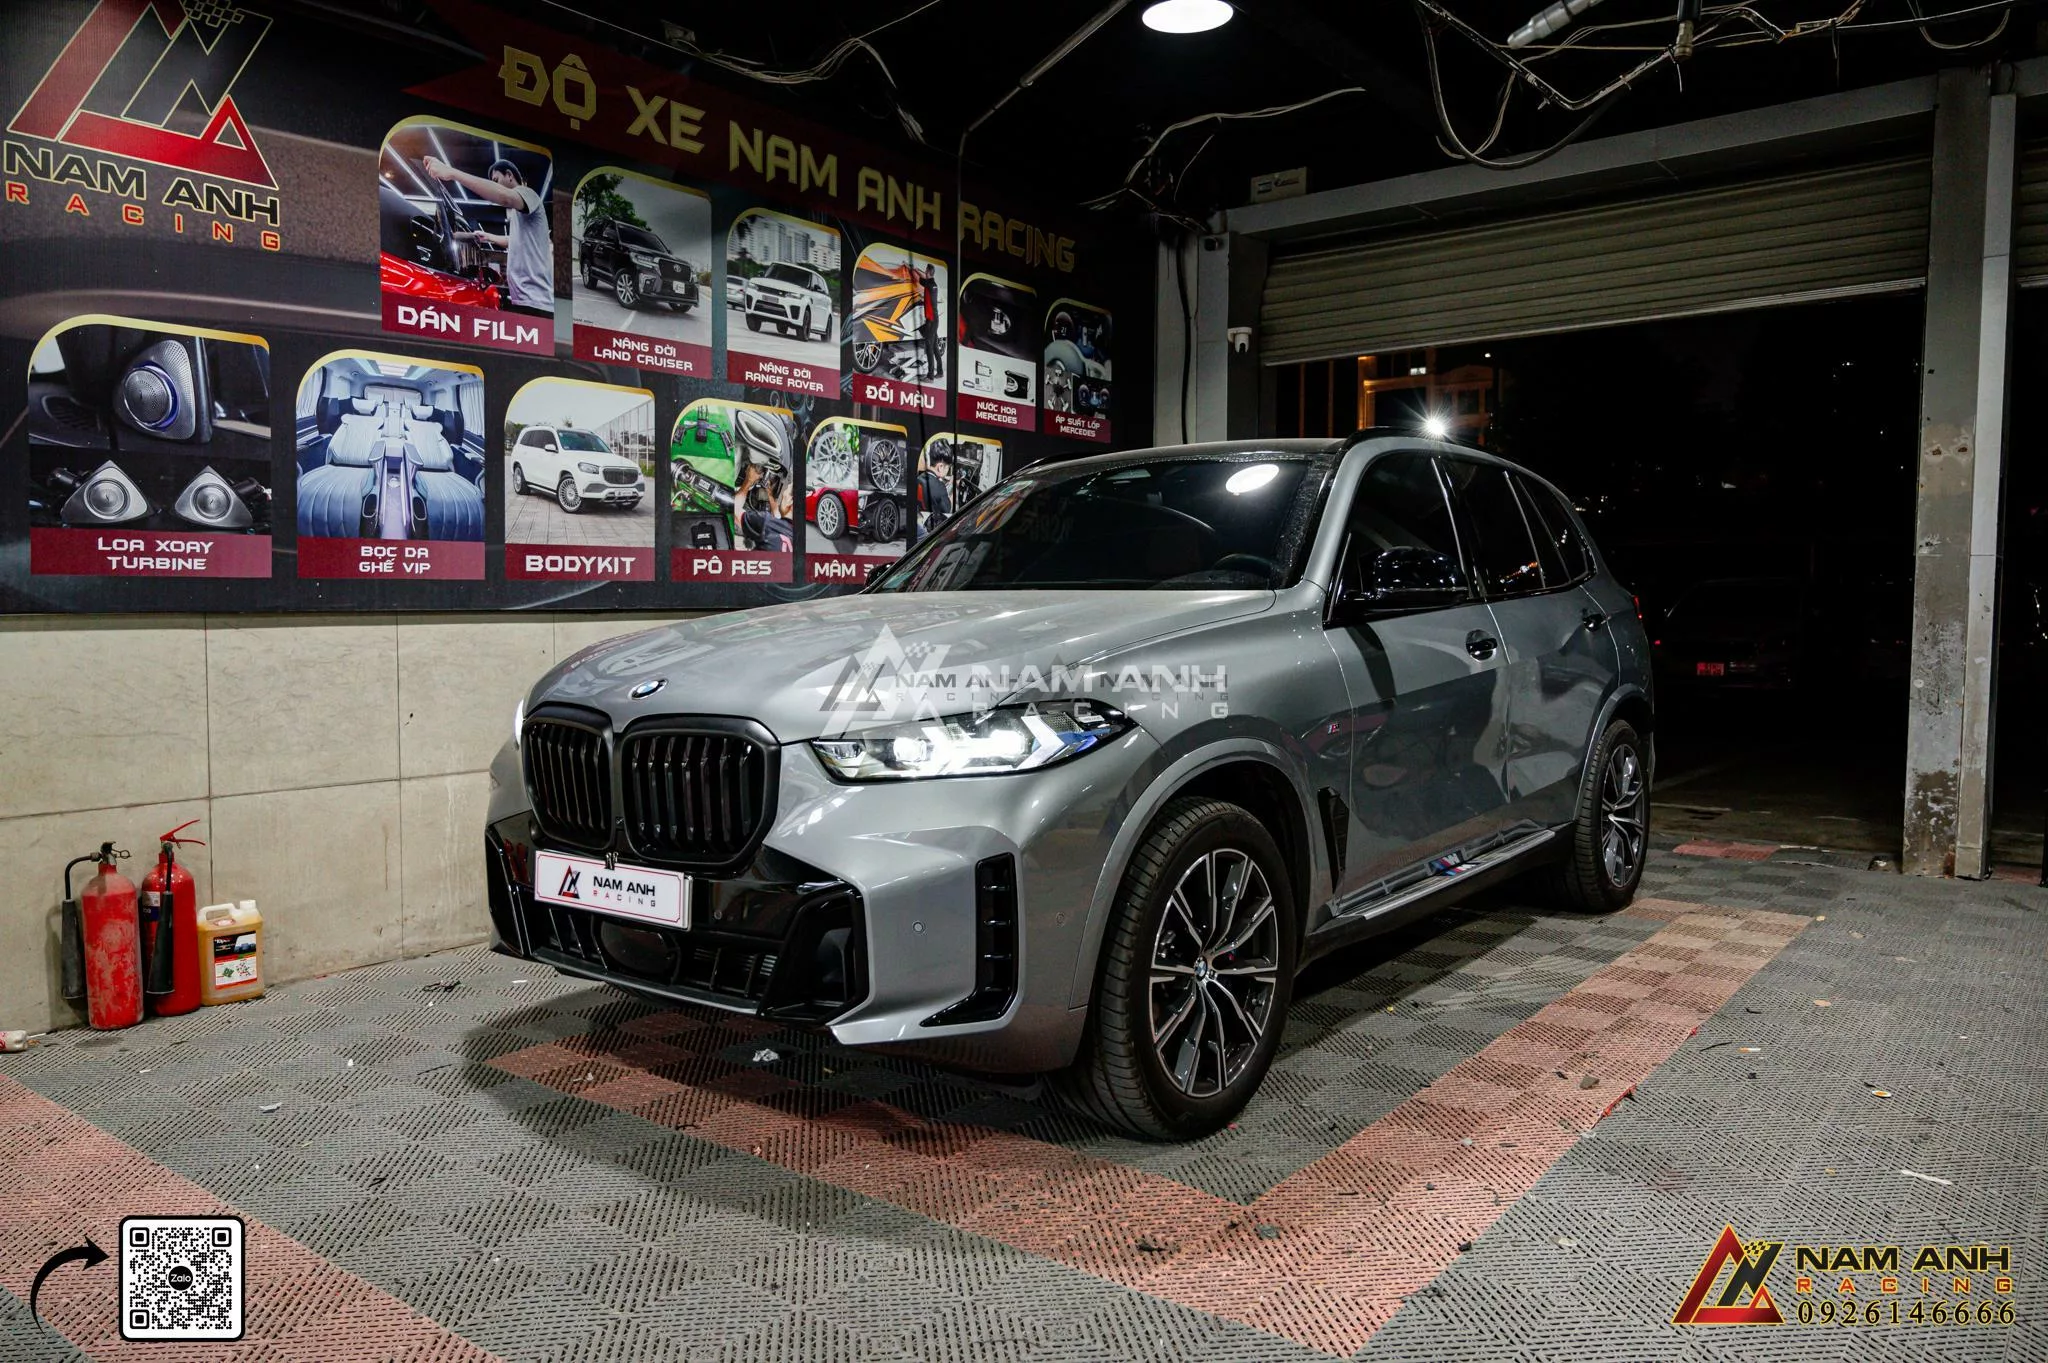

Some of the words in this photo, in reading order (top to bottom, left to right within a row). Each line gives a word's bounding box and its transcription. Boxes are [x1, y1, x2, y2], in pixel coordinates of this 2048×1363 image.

[498, 45, 597, 130] ĐỘ
[625, 85, 706, 154] XE
[729, 120, 838, 197] NAM
[857, 166, 941, 231] ANH
[959, 200, 1076, 273] RACING
[3, 141, 147, 200] NAM
[161, 178, 281, 227] ANH
[5, 181, 281, 251] RACING
[397, 304, 462, 334] DÁN
[473, 314, 540, 345] FILM
[612, 337, 649, 352] NÂNG
[654, 344, 676, 357] ĐỜI
[594, 346, 631, 361] LAND
[636, 354, 693, 371] CRUISER
[759, 361, 789, 375] NÂNG
[745, 371, 783, 385] RANGE
[787, 378, 824, 392] ROVER
[865, 381, 894, 404] ĐỔI
[900, 390, 935, 409] MÀU
[975, 410, 1018, 424] MERCEDES
[1000, 405, 1017, 415] HOA
[1055, 414, 1065, 424] ÁP
[1060, 425, 1096, 437] MERCEDES
[97, 536, 145, 552] LOA
[155, 539, 214, 555] XOAY
[360, 546, 398, 559] BỌC
[404, 546, 429, 559] DA
[106, 554, 207, 571] TURBINE
[359, 558, 396, 573] GHẾ
[402, 562, 431, 574] VIP
[525, 555, 636, 575] BODYKIT
[693, 556, 723, 576] PÔ
[731, 559, 772, 576] RES
[814, 559, 856, 578] MÂM
[592, 875, 623, 891] NAM
[626, 881, 656, 897] ANH
[592, 889, 656, 907] RACING
